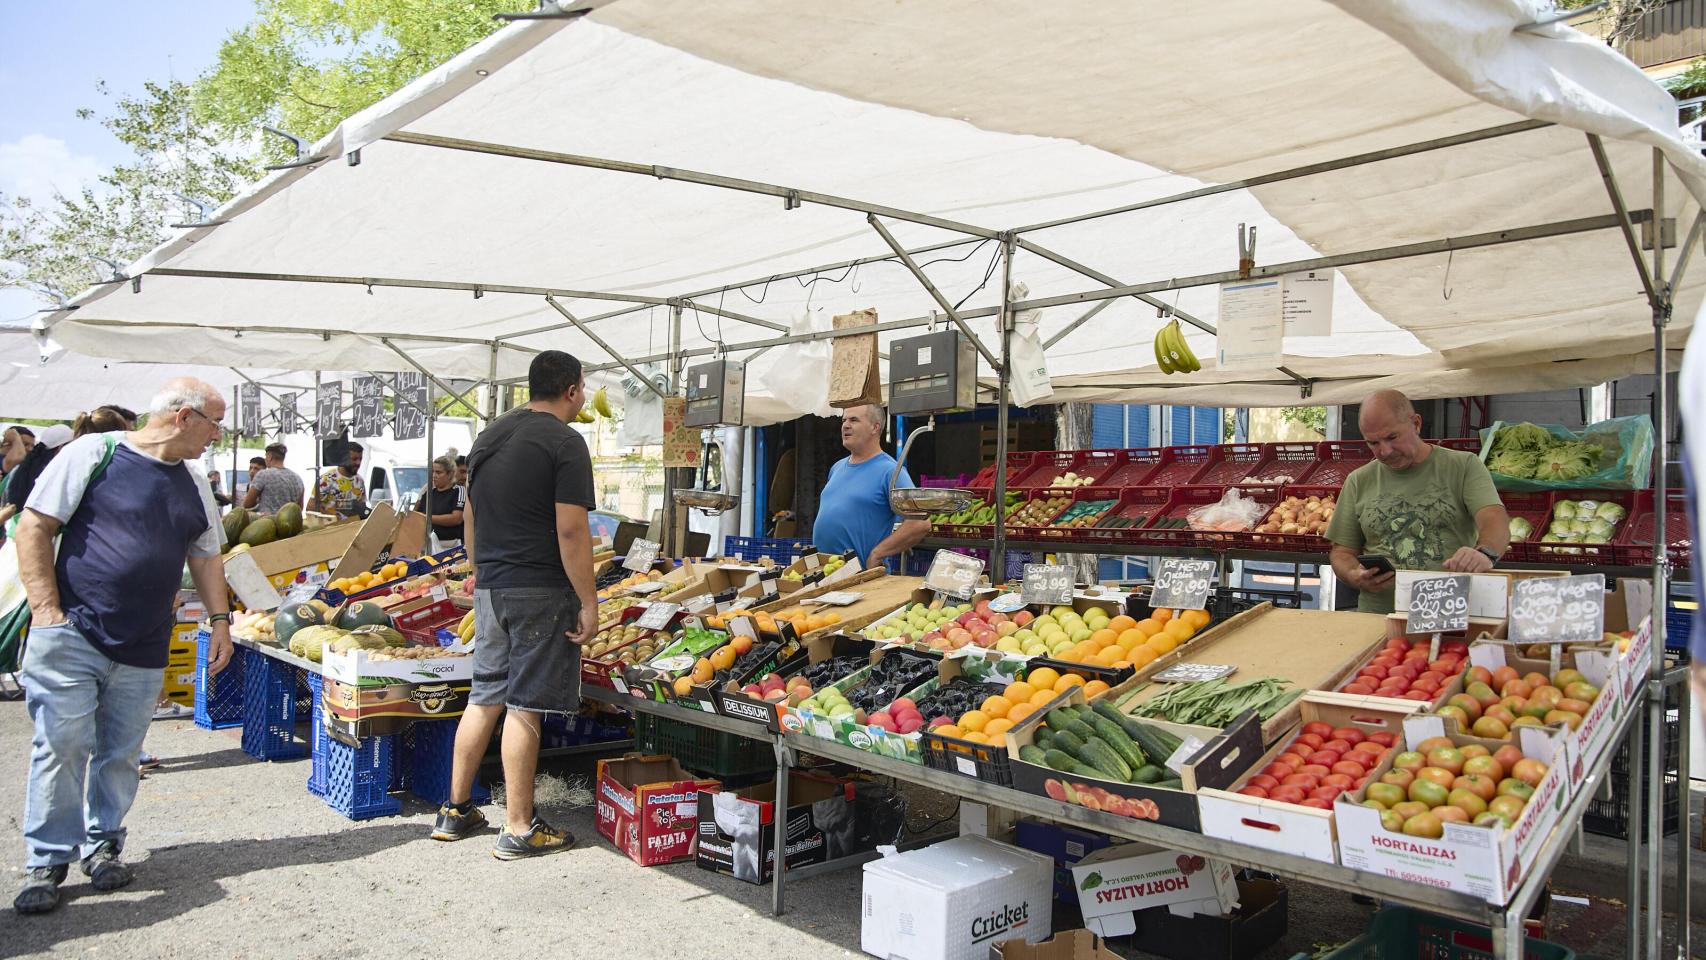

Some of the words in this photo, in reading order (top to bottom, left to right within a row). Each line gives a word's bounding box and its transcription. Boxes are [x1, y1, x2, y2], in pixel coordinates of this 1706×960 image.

[1414, 577, 1458, 592] PERA
[726, 700, 768, 720] DELISSIUM
[648, 793, 685, 805] Patatas
[1514, 768, 1560, 849] HORTALIZAS
[647, 831, 687, 849] PATATA
[1371, 835, 1457, 861] HORTALIZAS
[1120, 872, 1144, 883] VALERO
[1096, 876, 1190, 904] HORTALIZAS
[971, 901, 1029, 938] Cricket
